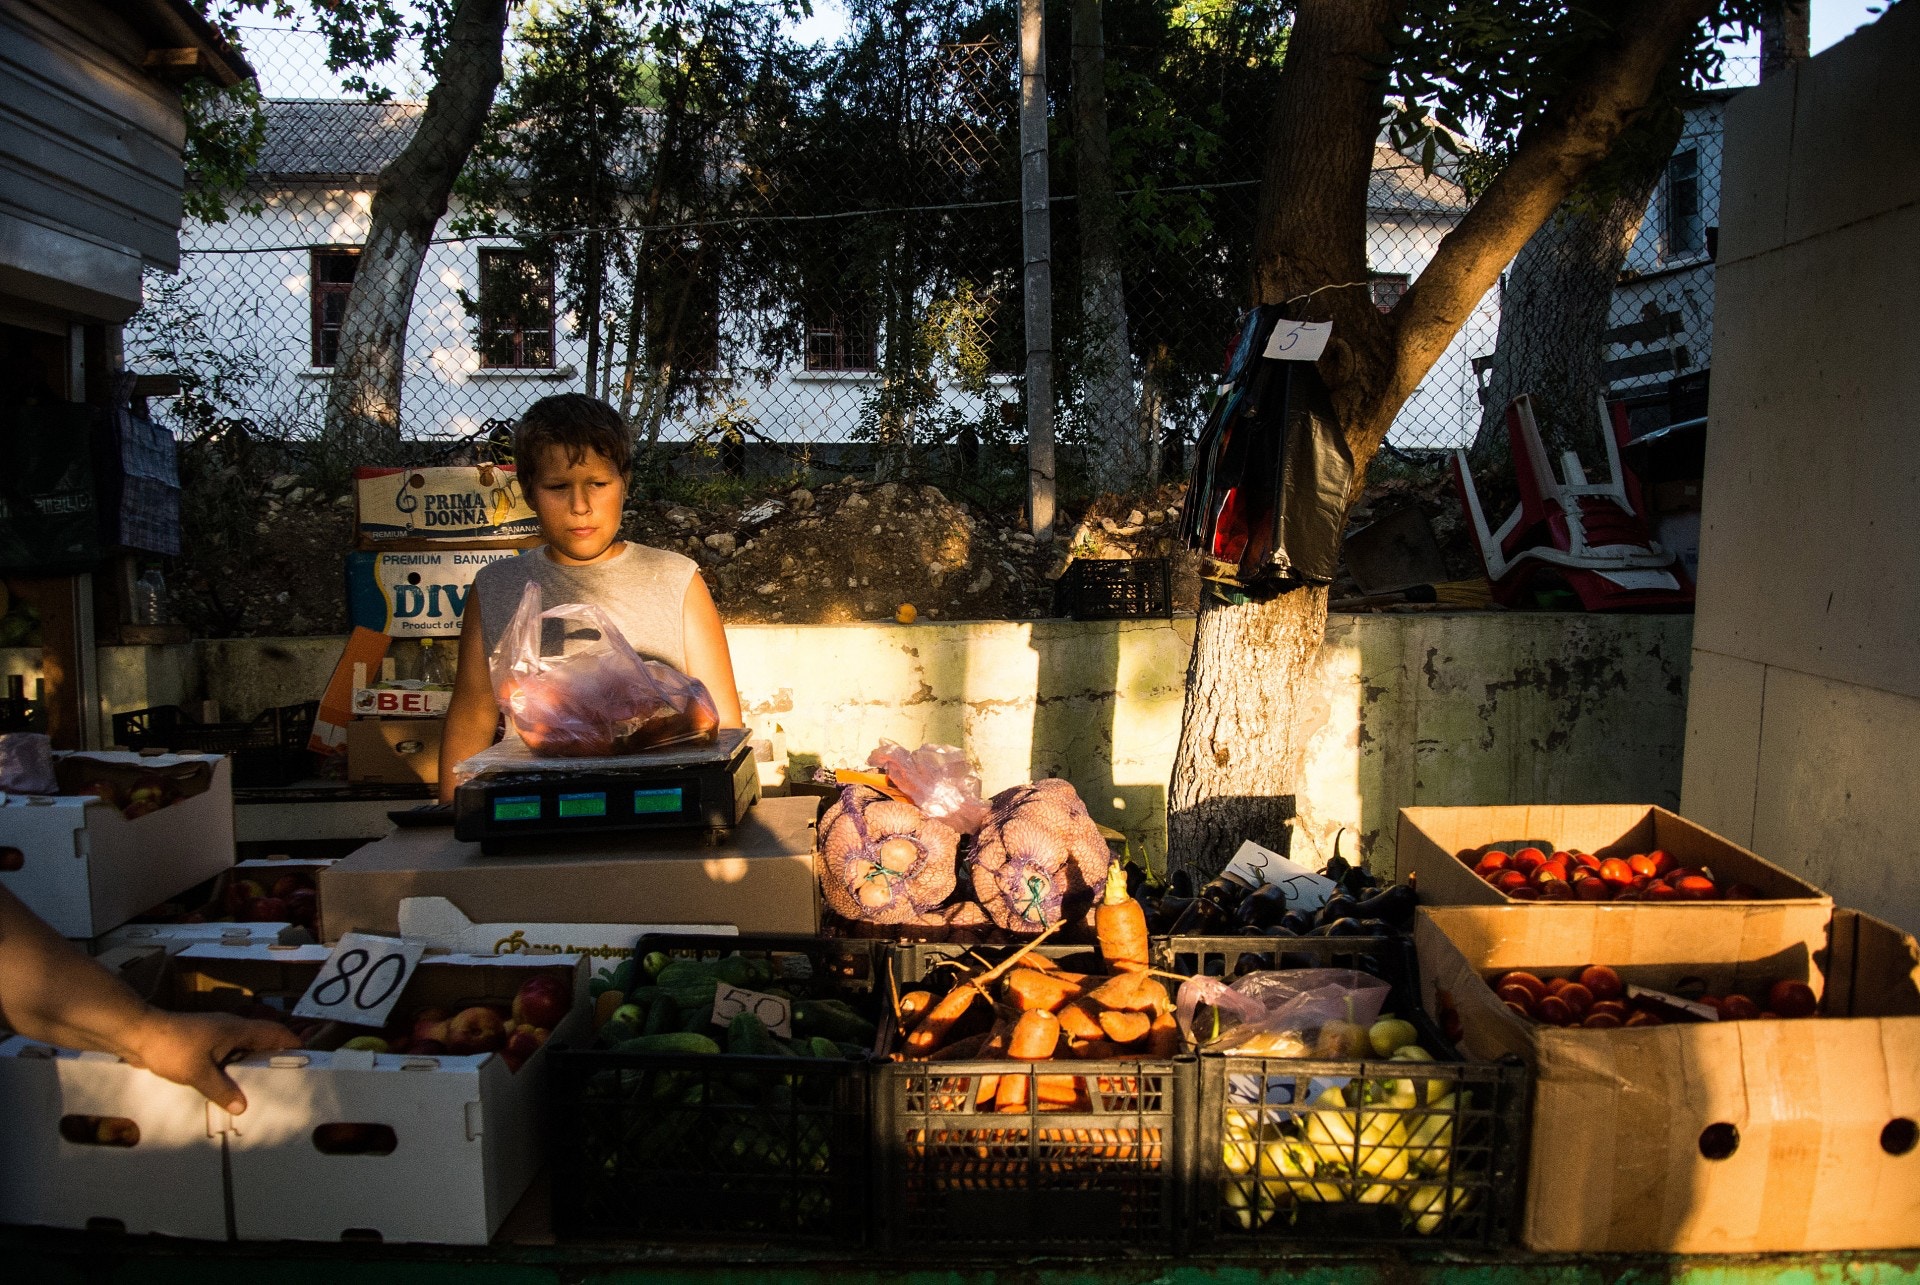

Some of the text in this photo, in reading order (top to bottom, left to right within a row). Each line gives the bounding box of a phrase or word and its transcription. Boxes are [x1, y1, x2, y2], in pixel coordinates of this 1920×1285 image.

[1279, 326, 1317, 351] 5
[424, 493, 486, 510] PRIMA
[424, 510, 489, 526] DONNA
[372, 530, 408, 538] REMIUM
[382, 555, 441, 565] PREMIUM
[402, 621, 441, 629] Product
[443, 621, 453, 629] of
[312, 948, 405, 1010] 80
[717, 989, 786, 1028] 50
